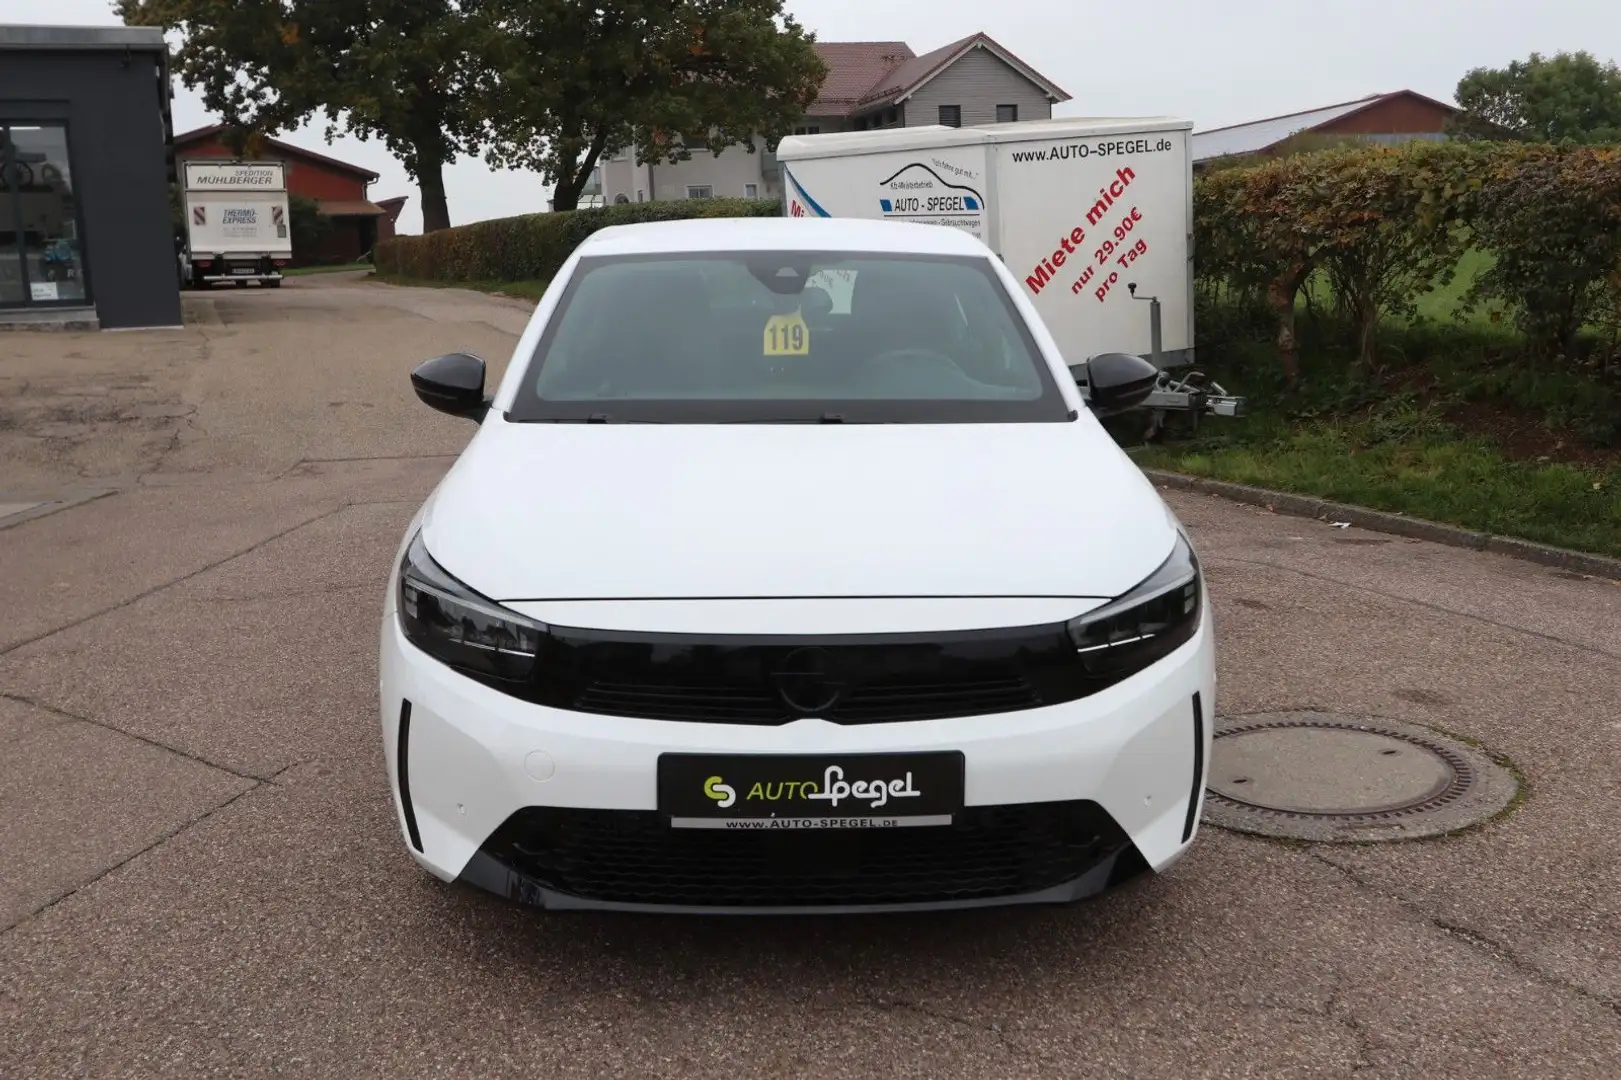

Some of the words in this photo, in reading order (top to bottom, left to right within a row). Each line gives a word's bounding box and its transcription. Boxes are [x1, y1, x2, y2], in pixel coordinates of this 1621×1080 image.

[1012, 138, 1172, 163] www.AUTO-SPEGEL.de
[894, 198, 919, 212] AUTO
[926, 196, 965, 212] SPEGEL
[222, 217, 257, 225] EXPRESS
[1025, 226, 1086, 295] Miete
[1086, 166, 1136, 226] mich
[1071, 265, 1095, 295] nur
[1095, 206, 1143, 265] 29.90€
[1095, 271, 1118, 303] pro
[1117, 238, 1148, 269] Tag
[769, 324, 803, 351] 119
